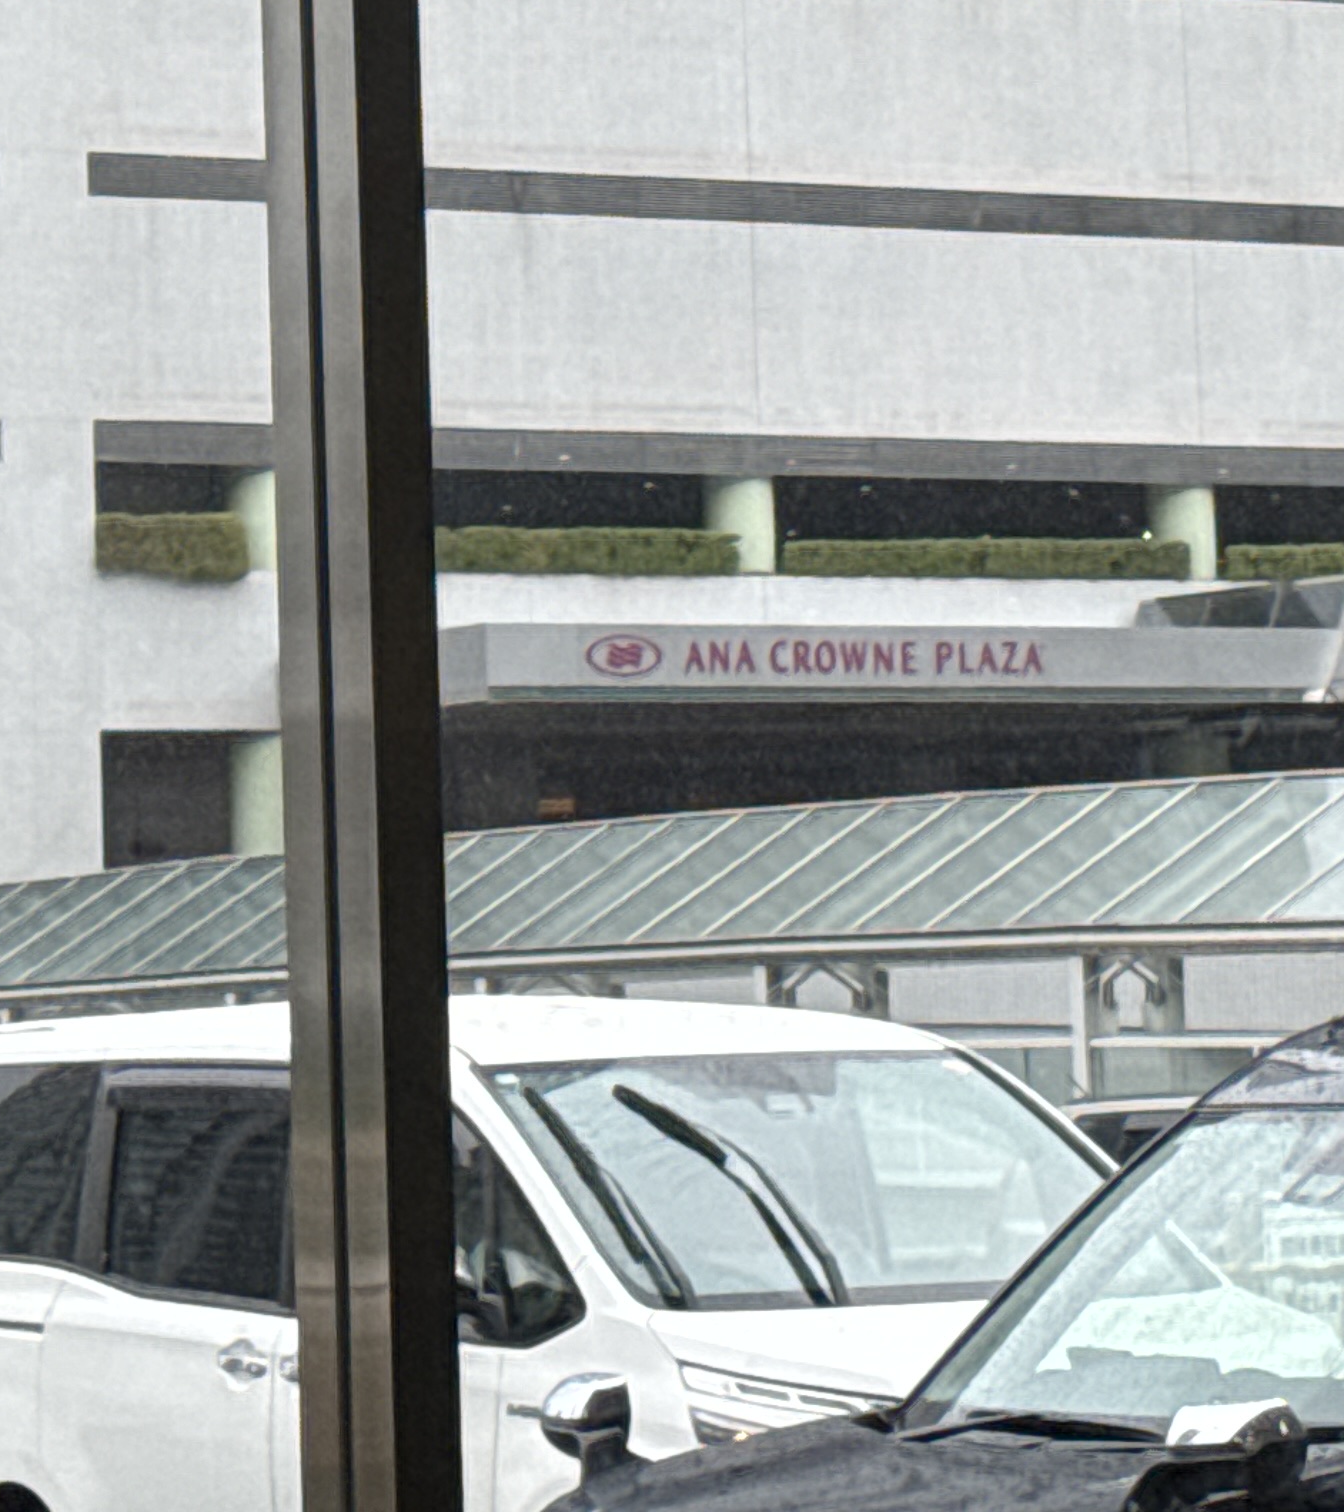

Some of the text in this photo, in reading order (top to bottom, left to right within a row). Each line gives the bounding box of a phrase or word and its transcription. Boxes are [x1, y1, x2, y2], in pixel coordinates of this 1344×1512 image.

[684, 638, 1045, 676] ANA CROWNE PLAZA
